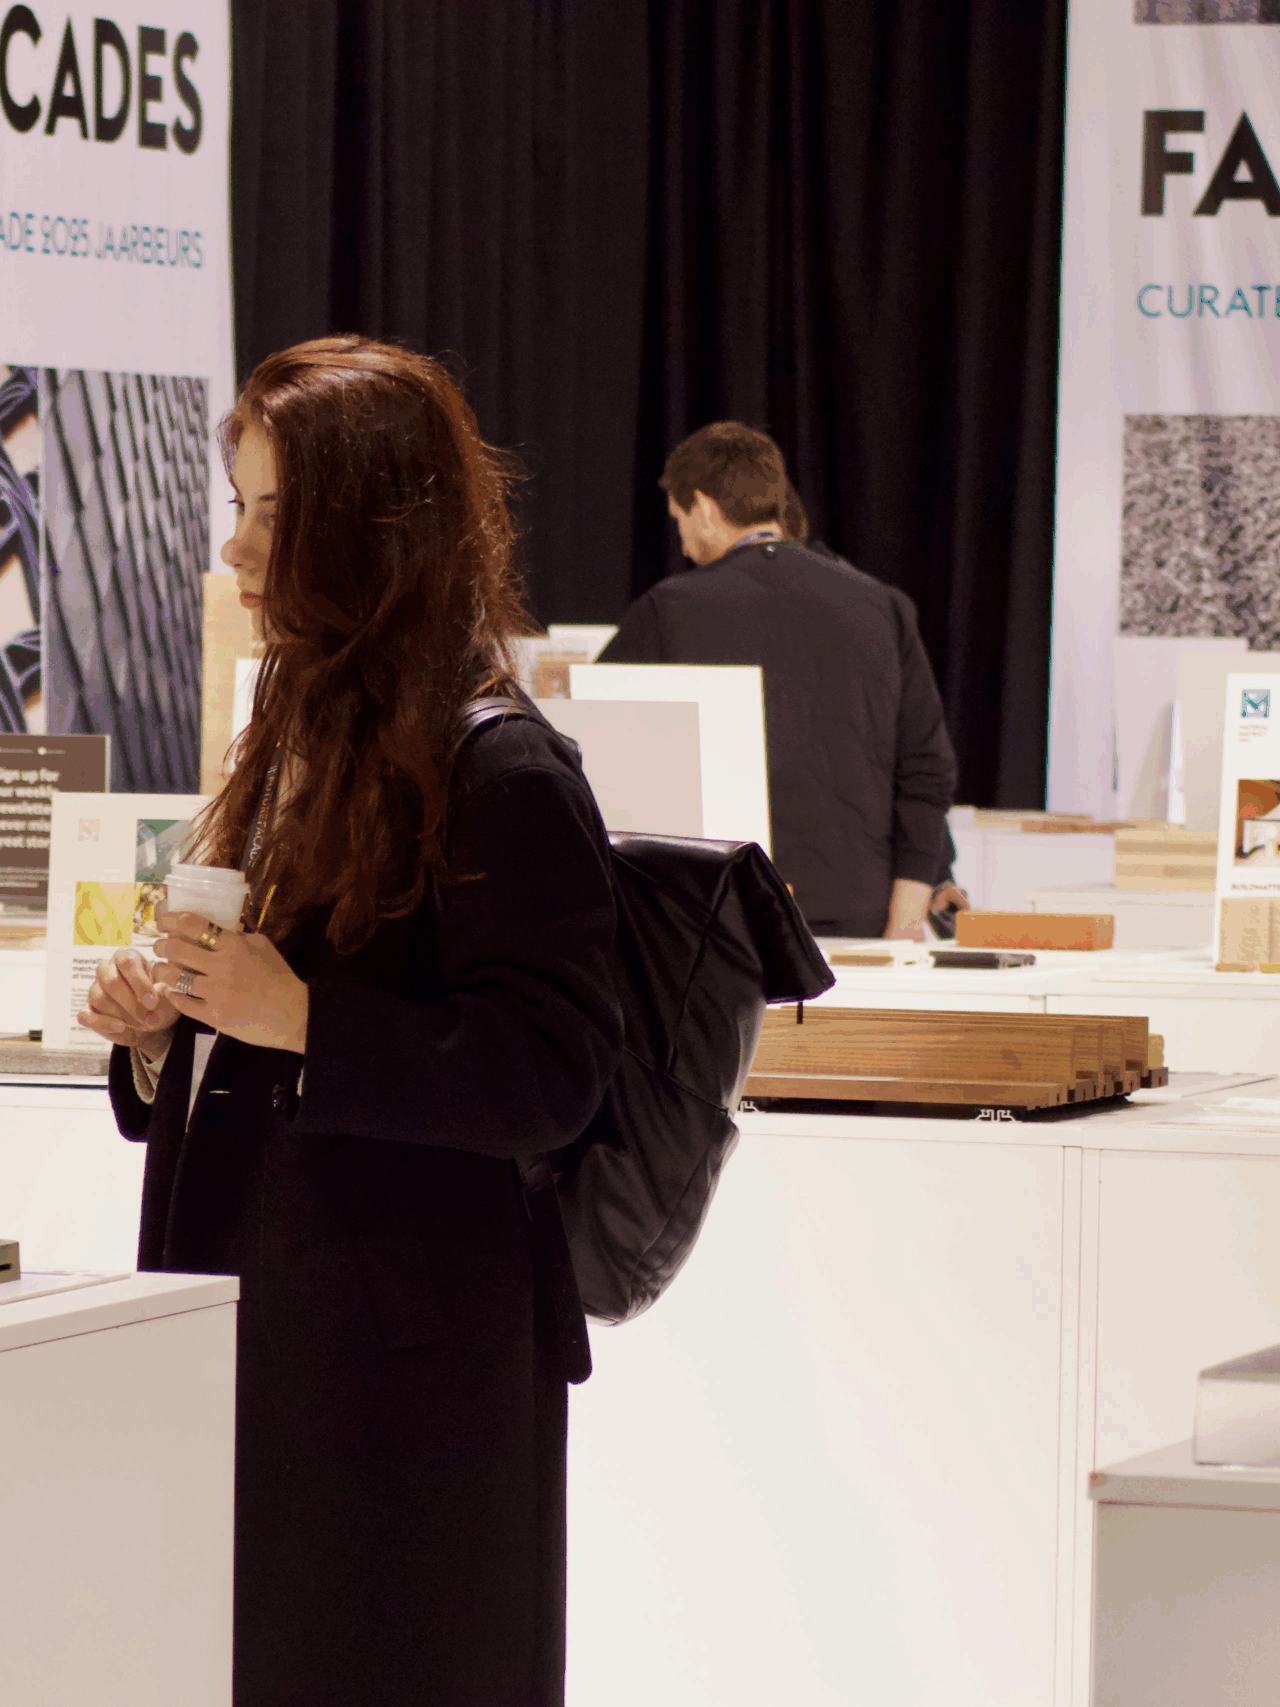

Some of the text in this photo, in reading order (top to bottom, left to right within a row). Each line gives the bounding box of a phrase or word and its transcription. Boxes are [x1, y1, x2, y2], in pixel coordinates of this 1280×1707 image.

[1141, 109, 1280, 217] FA
[96, 221, 204, 270] JAARBEURS
[1136, 284, 1280, 319] CURAT
[21, 769, 38, 785] up
[40, 768, 60, 782] for
[28, 819, 51, 832] mis
[26, 836, 50, 848] stor
